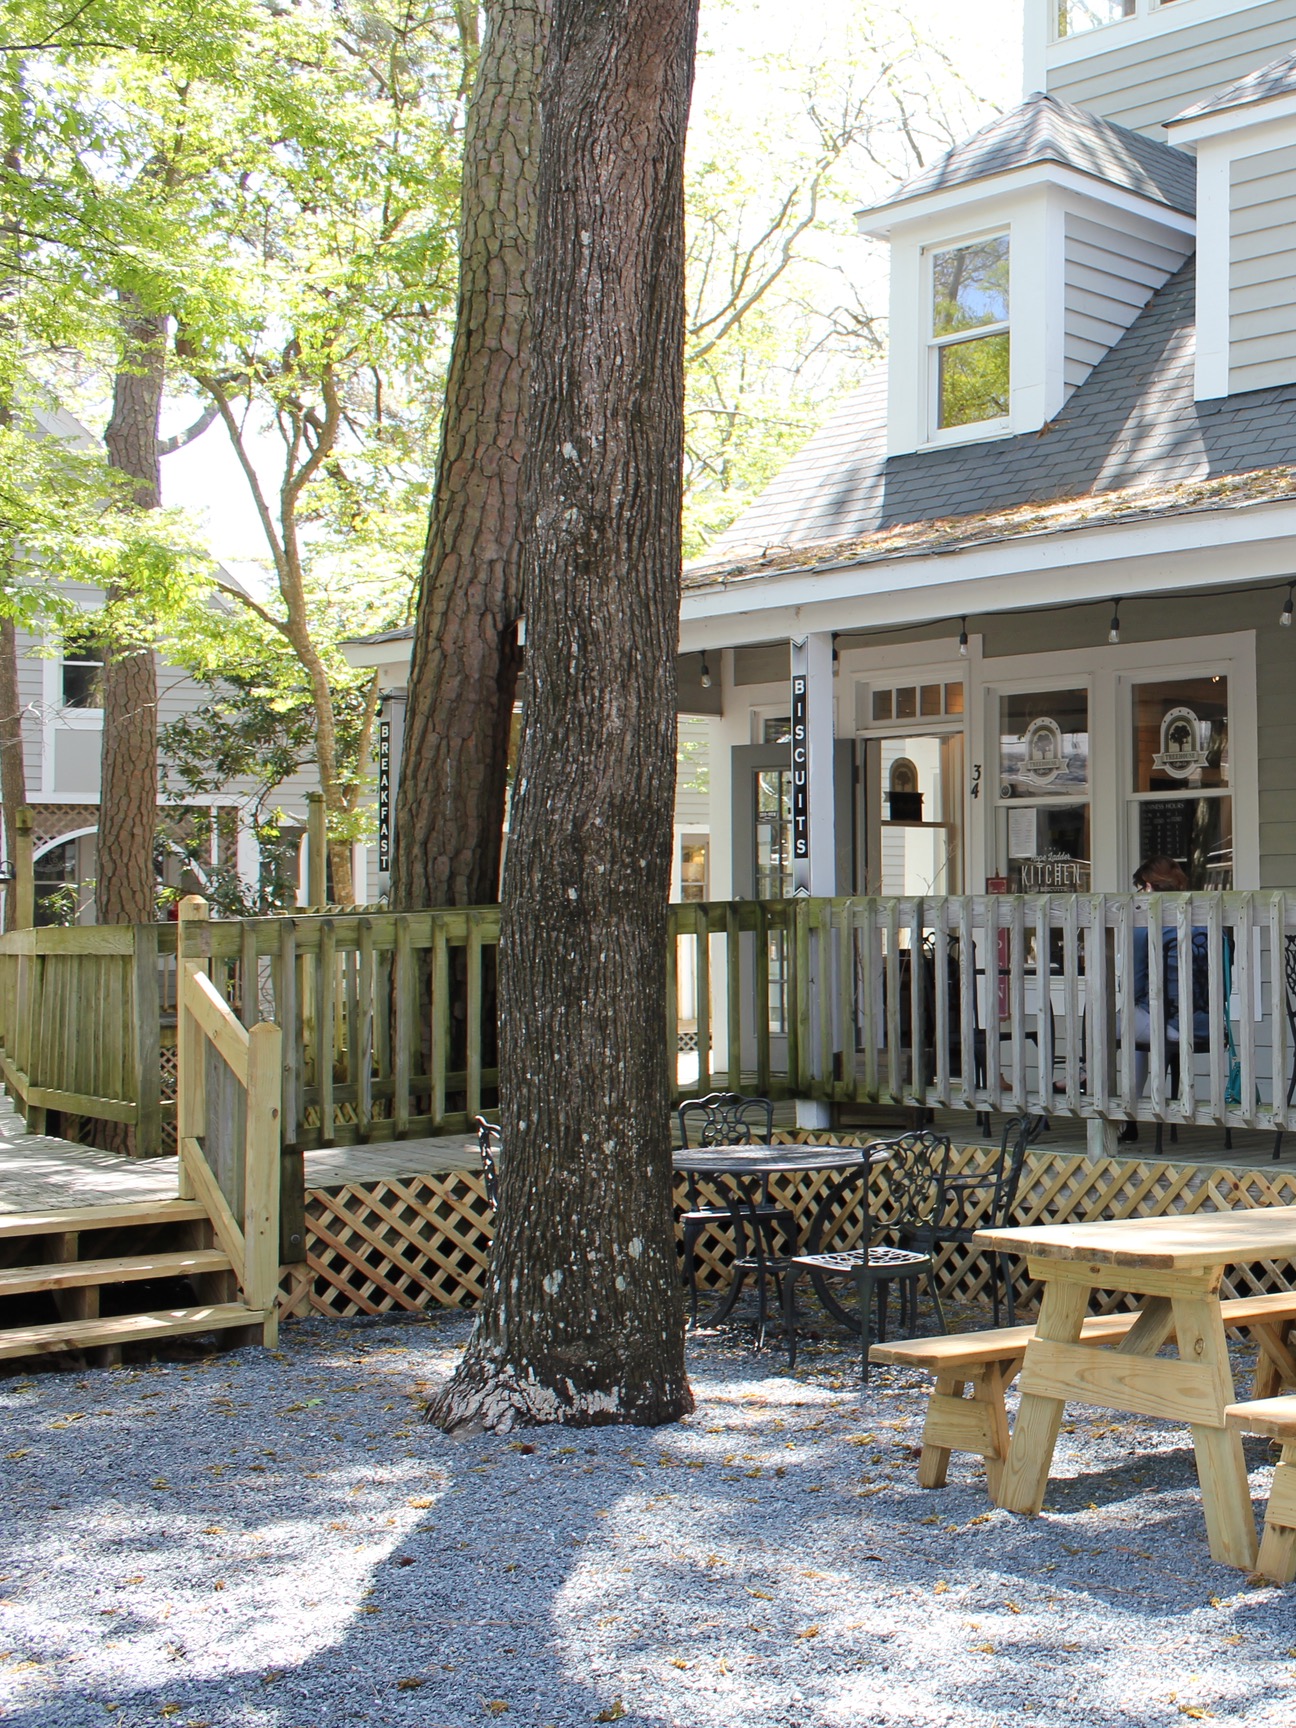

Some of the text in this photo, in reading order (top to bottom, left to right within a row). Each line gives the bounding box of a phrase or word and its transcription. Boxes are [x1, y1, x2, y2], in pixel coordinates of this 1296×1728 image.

[794, 679, 806, 854] BISCUITS
[1029, 759, 1058, 768] TREEHOUSE
[1165, 752, 1196, 761] TREEHOUSE
[970, 764, 982, 800] 34
[380, 725, 390, 869] BREAKFAST
[1047, 851, 1071, 863] Ladder
[1021, 863, 1081, 885] KITCHEN
